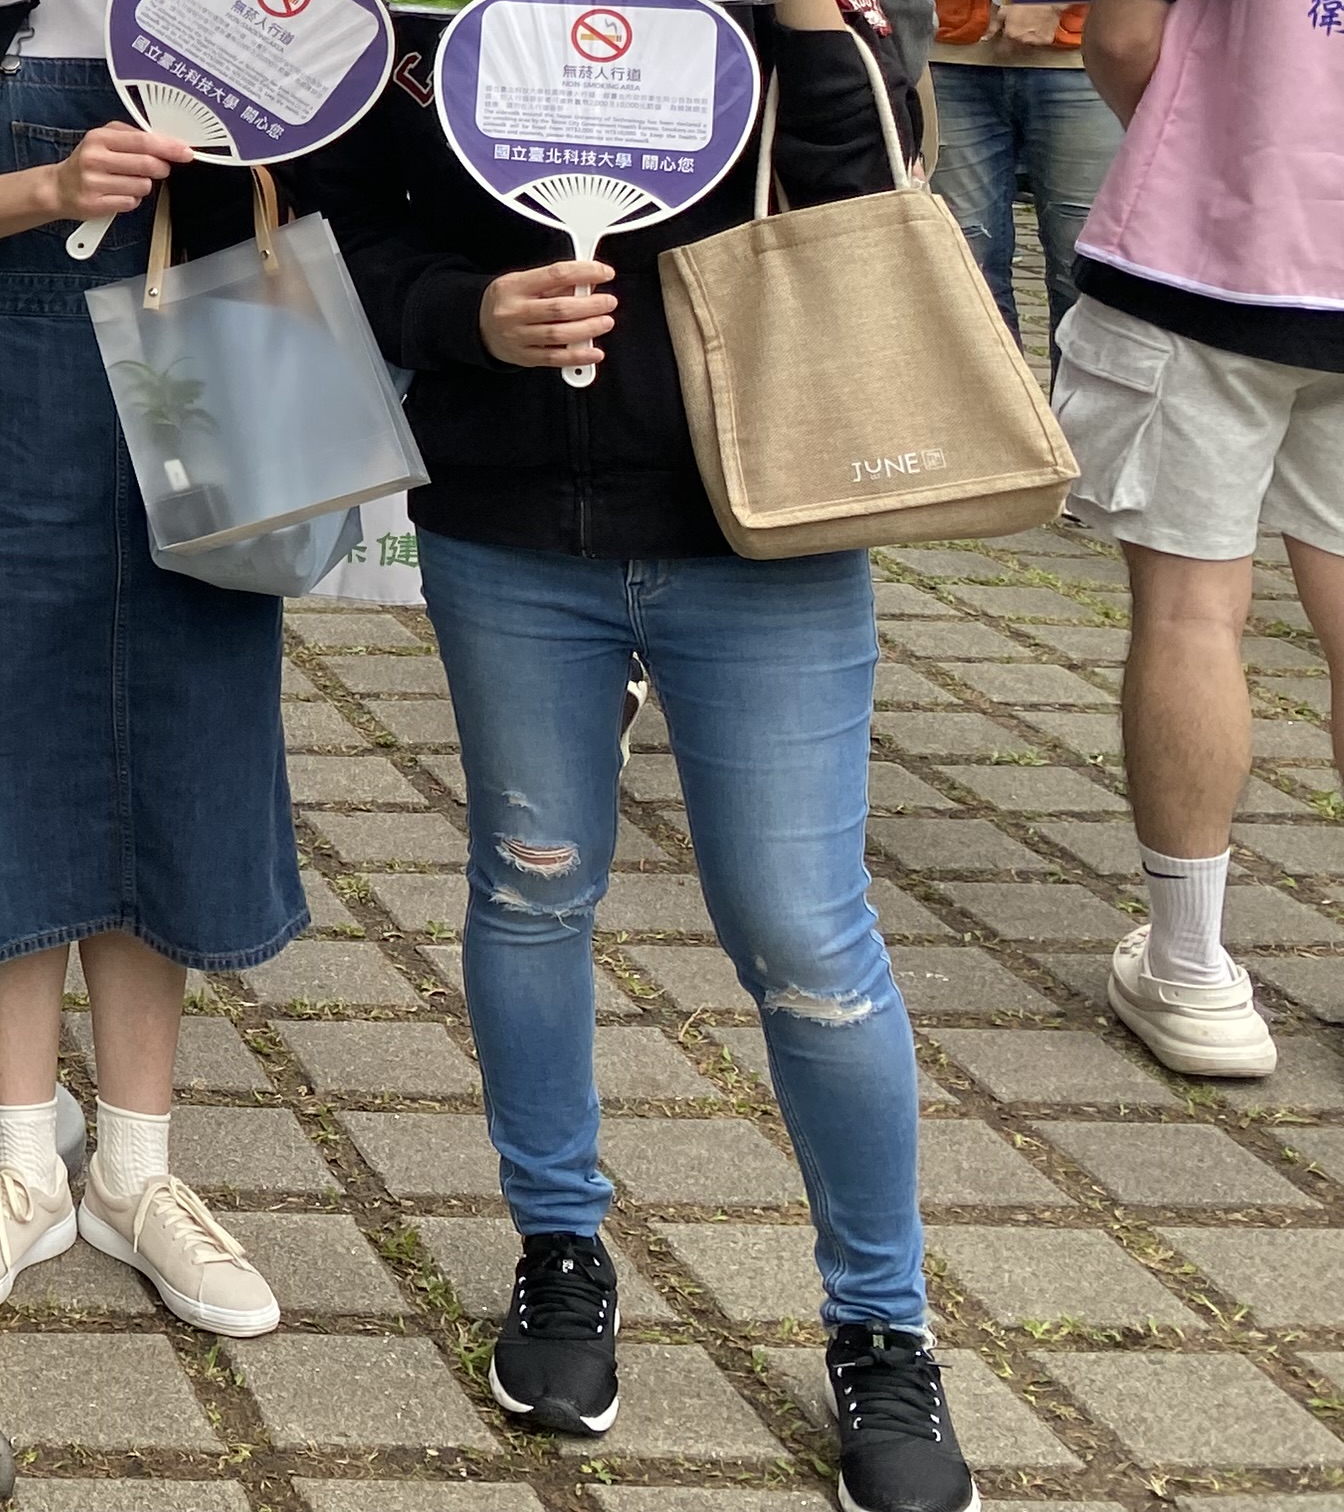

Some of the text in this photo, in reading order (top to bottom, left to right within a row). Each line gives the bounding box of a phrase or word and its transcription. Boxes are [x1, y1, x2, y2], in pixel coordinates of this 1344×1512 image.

[230, 0, 296, 46] 無菸人行道
[132, 35, 238, 112] 國立臺北科技大學
[240, 104, 285, 140] 關心您
[562, 64, 642, 83] 無菸人行道
[494, 143, 695, 174] 國立臺北科技大學 關心您
[851, 452, 921, 483] JUNE
